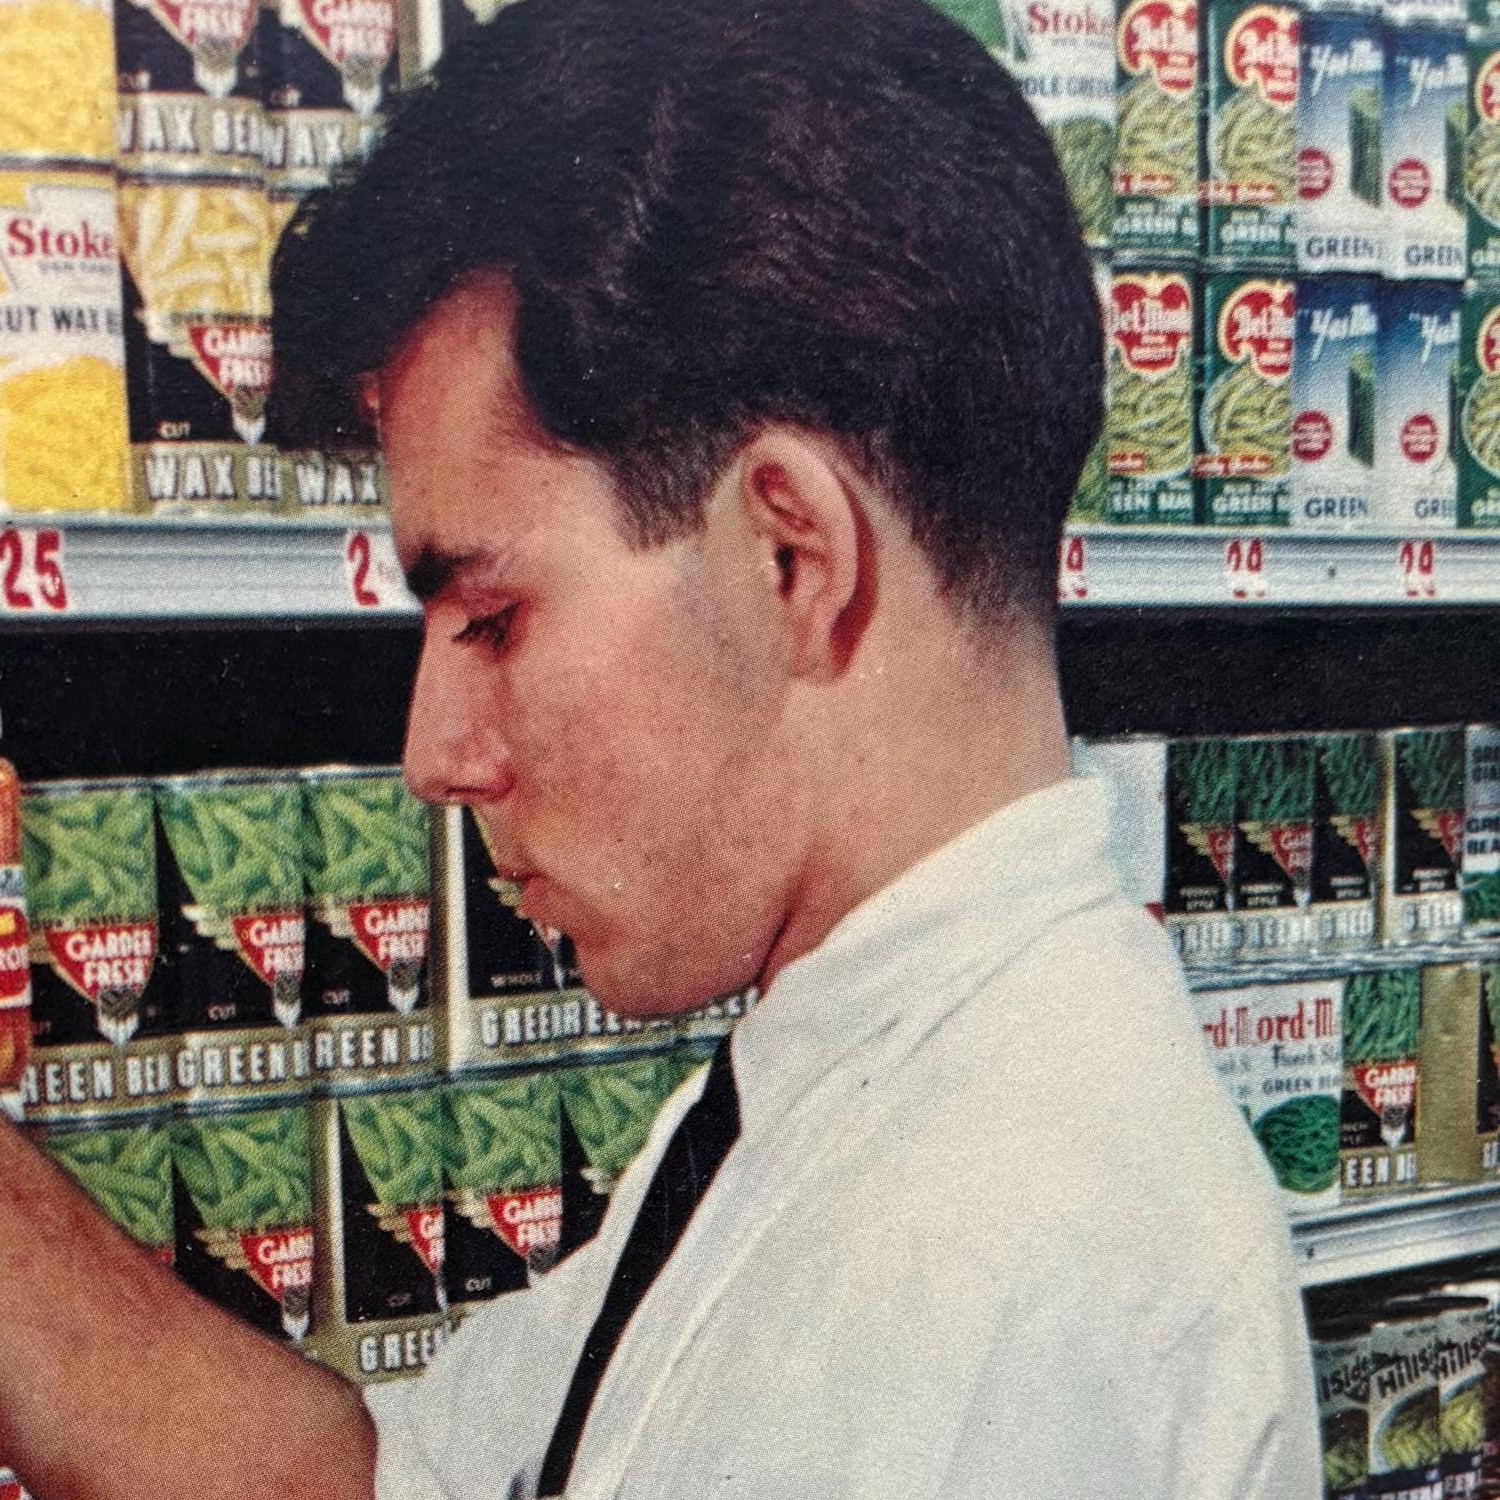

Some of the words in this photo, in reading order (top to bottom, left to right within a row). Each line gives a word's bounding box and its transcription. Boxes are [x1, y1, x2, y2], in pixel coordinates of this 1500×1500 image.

[1306, 237, 1374, 259] GREEN
[160, 420, 192, 440] CUT
[146, 456, 234, 502] WAX
[296, 456, 381, 508] WAX
[1305, 497, 1369, 520] GREEN
[177, 1040, 285, 1088] GREEN
